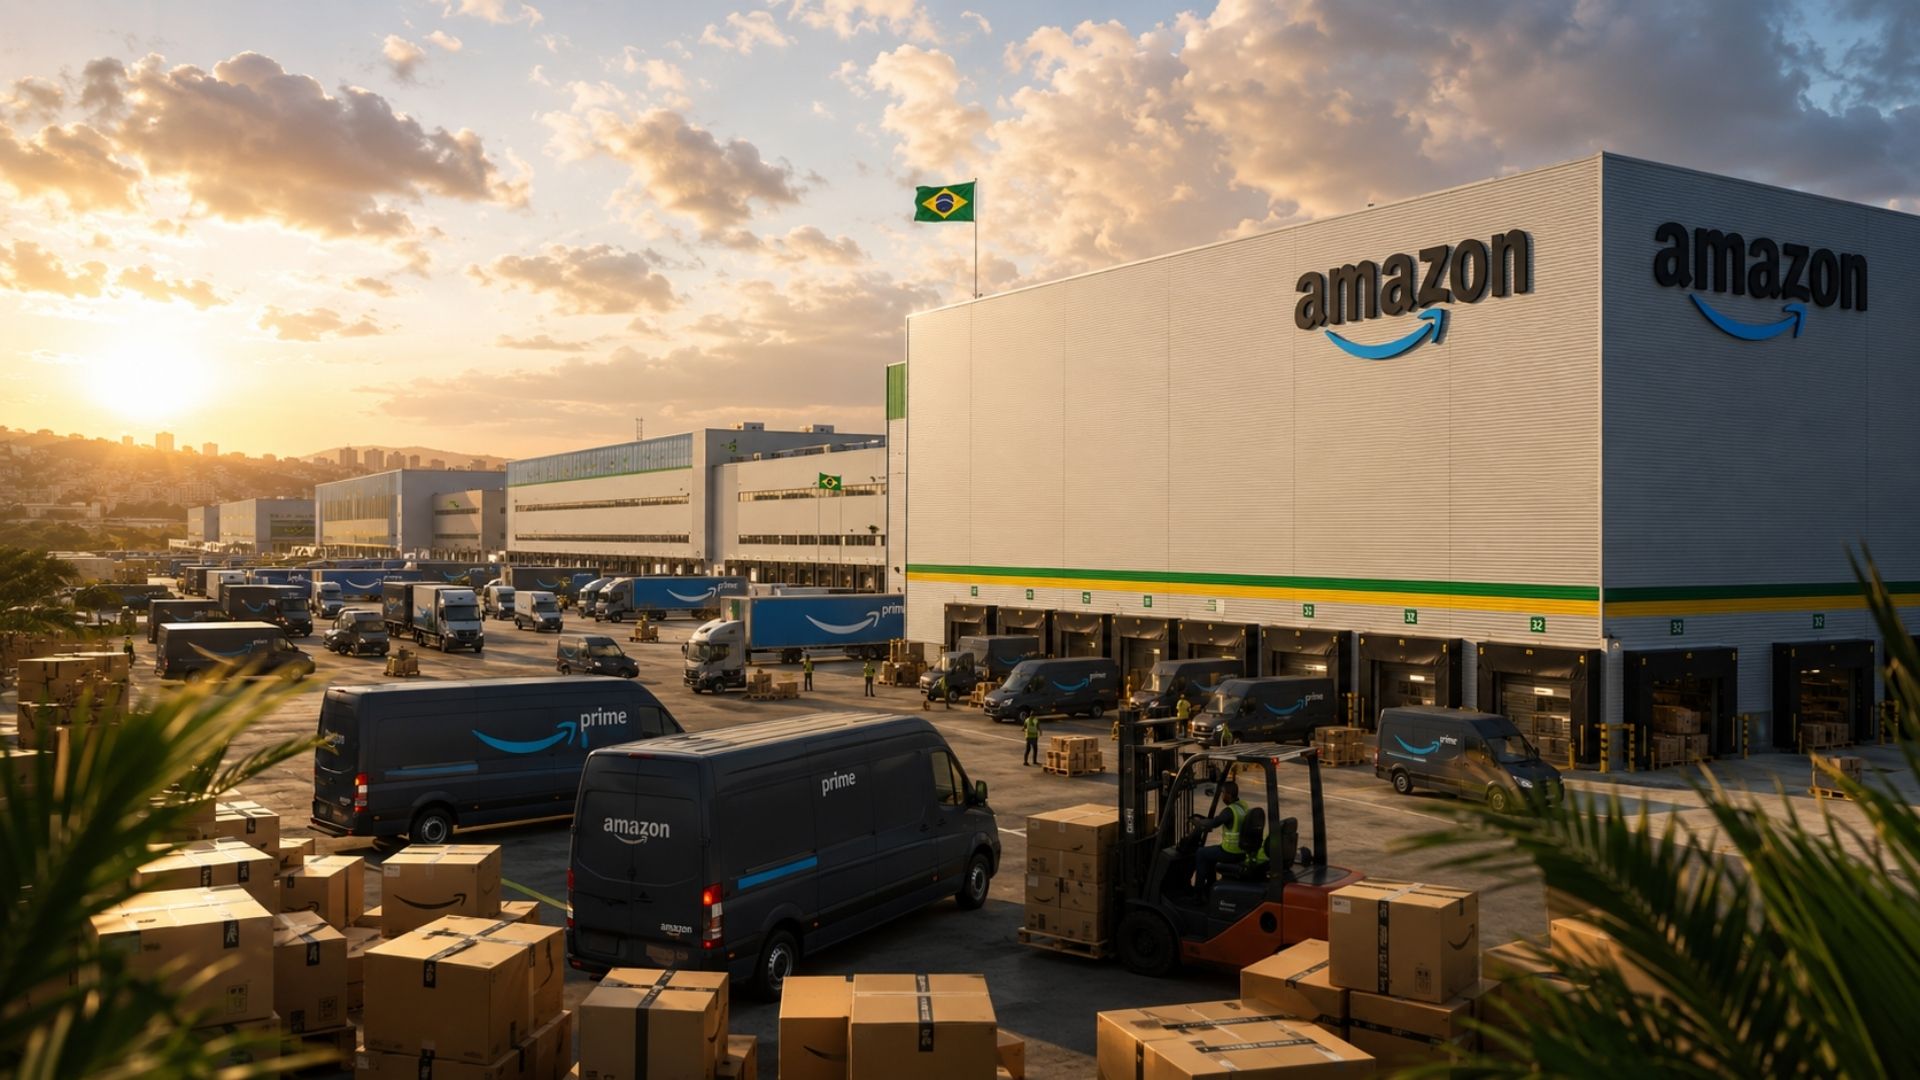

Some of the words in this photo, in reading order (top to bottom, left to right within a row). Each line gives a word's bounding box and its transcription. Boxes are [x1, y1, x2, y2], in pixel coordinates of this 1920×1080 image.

[1295, 228, 1533, 330] amazon
[1653, 221, 1868, 312] amazon
[882, 601, 905, 618] prim
[1531, 620, 1543, 631] 32
[580, 706, 628, 733] prime
[821, 771, 857, 797] prime
[603, 817, 671, 839] amazon
